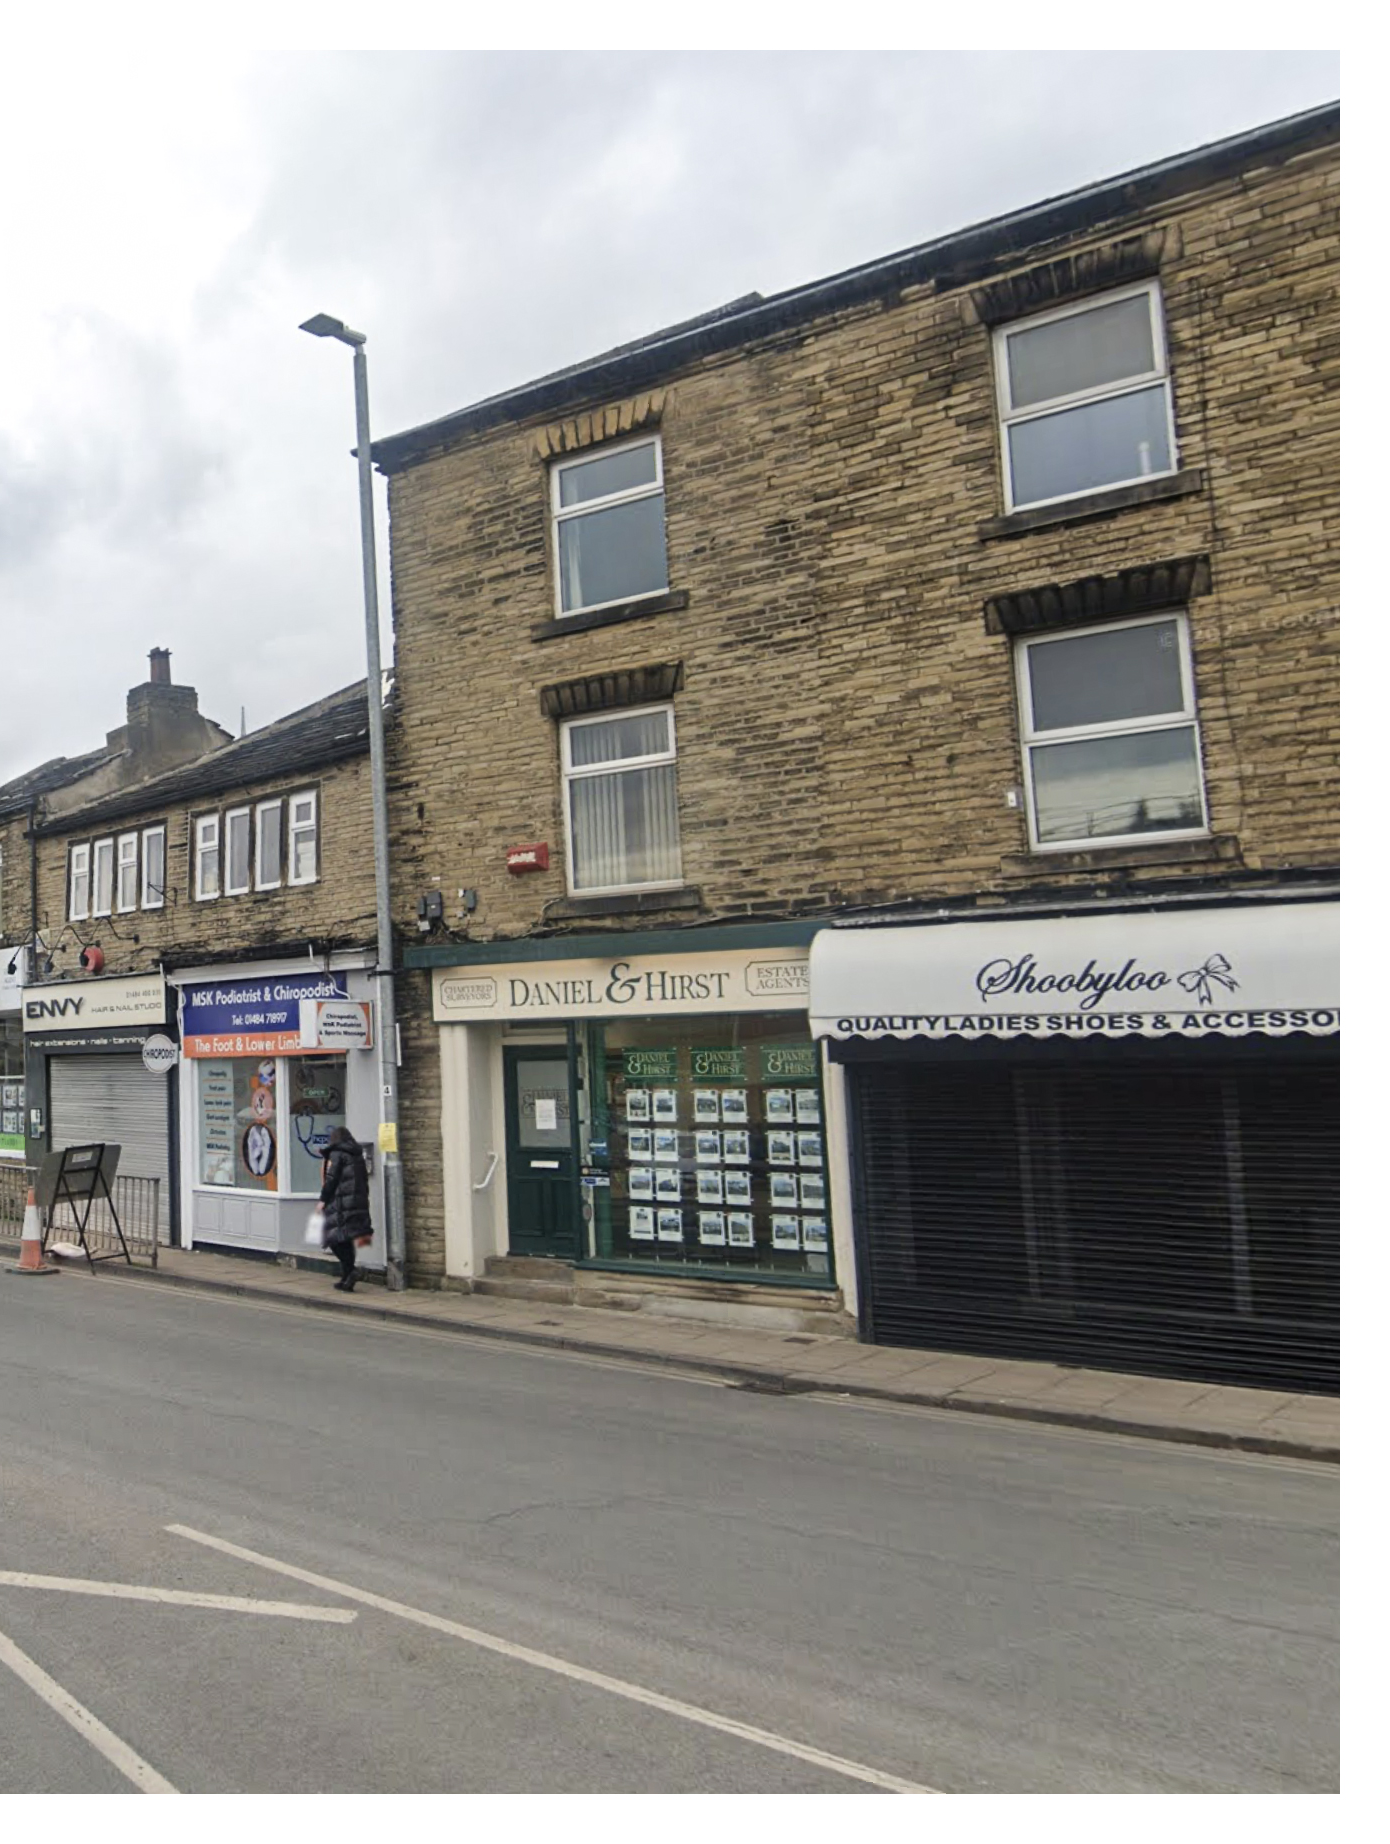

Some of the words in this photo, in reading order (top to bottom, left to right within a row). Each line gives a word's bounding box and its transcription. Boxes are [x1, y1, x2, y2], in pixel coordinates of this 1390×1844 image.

[757, 965, 809, 978] ESTATE
[444, 984, 492, 995] CHARTERED
[509, 978, 602, 1007] DANIEL
[606, 962, 642, 1004] &
[645, 970, 730, 1001] HIRST
[756, 978, 810, 989] AGENTS
[976, 953, 1172, 1010] Shoobyloo
[192, 990, 212, 1006] MSK
[215, 988, 261, 1006] Podiatrist
[263, 987, 271, 1002] &
[274, 981, 336, 1001] Chiropodist
[26, 997, 83, 1020] ENVY
[134, 1002, 162, 1010] STUDIO
[245, 1013, 264, 1025] 01484
[1046, 1014, 1144, 1031] SHOES
[1152, 1014, 1172, 1030] &
[1182, 1010, 1340, 1030] ACCESSO
[30, 1040, 44, 1048] hair
[45, 1038, 87, 1047] extensions
[90, 1038, 108, 1046] nails
[112, 1036, 146, 1046] tanning
[194, 1038, 211, 1053] The
[212, 1037, 234, 1052] Foot
[236, 1036, 244, 1052] &
[245, 1035, 275, 1051] Lower
[277, 1034, 301, 1050] Limb
[627, 1053, 641, 1075] &
[643, 1063, 671, 1075] HIRST
[636, 1052, 670, 1063] DANIEL
[695, 1052, 709, 1074] &
[712, 1063, 740, 1075] HIRST
[705, 1051, 739, 1063] DANIEL
[767, 1052, 782, 1073] &
[785, 1062, 815, 1075] HIRST
